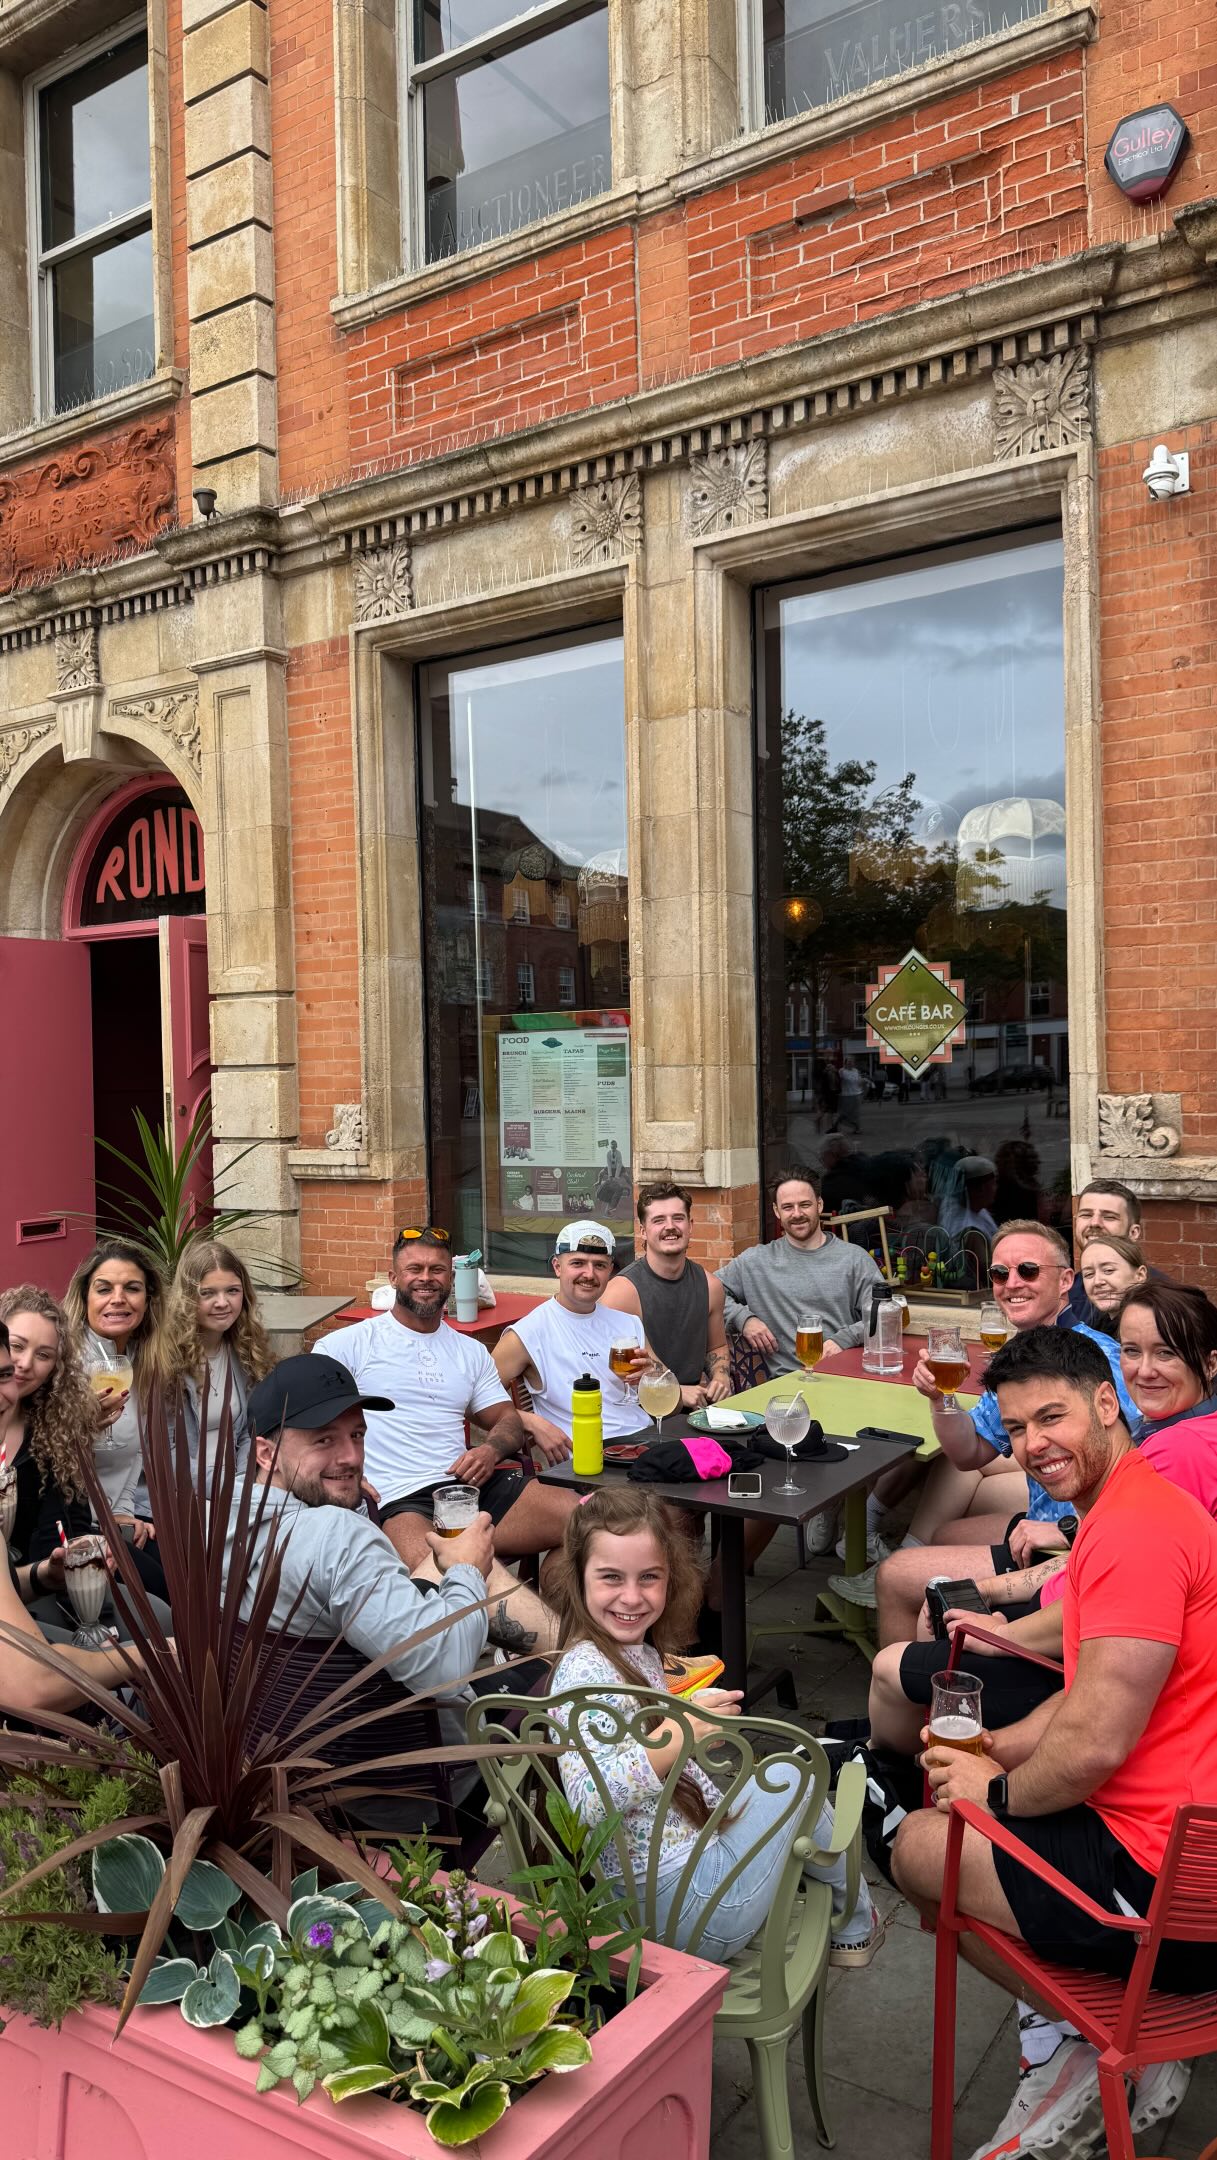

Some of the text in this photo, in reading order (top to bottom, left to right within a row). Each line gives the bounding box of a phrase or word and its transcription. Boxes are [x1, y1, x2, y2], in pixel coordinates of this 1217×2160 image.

[824, 0, 985, 88] VALUERS
[1113, 127, 1176, 157] Gulley
[1150, 144, 1163, 154] Ltd
[876, 1002, 954, 1022] CAFÉ BAR
[502, 1036, 530, 1045] FOOD
